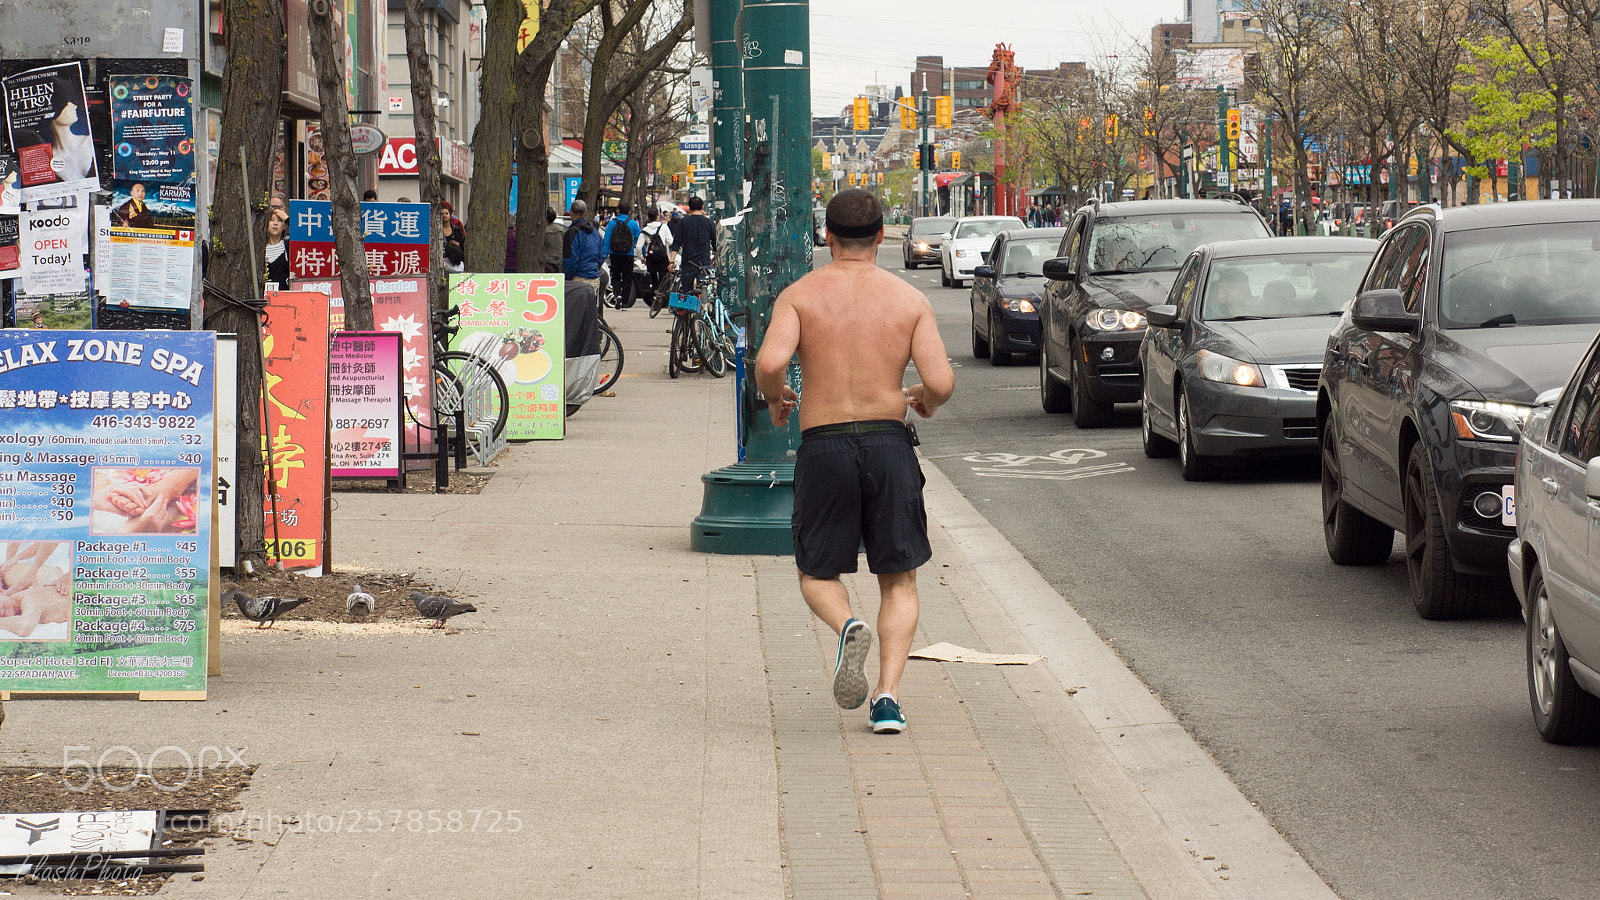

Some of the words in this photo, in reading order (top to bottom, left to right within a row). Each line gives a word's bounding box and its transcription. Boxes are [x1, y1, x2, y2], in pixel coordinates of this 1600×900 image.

[10, 82, 55, 100] HELEN
[10, 101, 19, 110] of
[20, 94, 53, 110] TROY
[121, 107, 186, 118] #FAIRFUTURE
[684, 142, 704, 150] Grange
[160, 189, 191, 199] KARMAPA
[29, 214, 70, 230] koodo
[297, 206, 422, 239] 中貨運
[34, 238, 68, 250] OPEN
[32, 253, 72, 266] Today!
[376, 280, 418, 294] Garden
[66, 339, 145, 367] ZONE
[150, 348, 205, 387] SPA
[92, 415, 197, 429] 416-343-9822
[335, 418, 390, 429] 887-2697
[48, 435, 87, 446] (60min,
[89, 437, 112, 445] Include
[113, 437, 128, 445] soak
[129, 437, 142, 445] foot
[179, 434, 202, 445] $32
[24, 452, 34, 463] &
[37, 451, 96, 466] Massage
[98, 454, 140, 465] (45min)
[179, 452, 202, 464] $40
[17, 470, 77, 485] Massage
[52, 484, 75, 495] $30
[51, 497, 75, 508] $40
[51, 510, 74, 521] $50
[77, 541, 130, 555] Package
[176, 541, 198, 552] $45
[76, 554, 106, 564] 30min
[107, 554, 128, 564] Foot
[137, 554, 167, 564] 30min
[167, 554, 191, 566] Body
[76, 567, 129, 581] Package
[175, 567, 197, 579] $55
[76, 581, 105, 591] 60min
[106, 581, 127, 591] Foot
[136, 581, 166, 591] 30min
[166, 581, 191, 593] Body
[75, 593, 129, 607] Package
[174, 594, 196, 605] $65
[75, 607, 104, 617] 30min
[105, 607, 126, 617] Foot
[135, 607, 165, 617] 60min
[165, 607, 190, 619] Body
[74, 619, 128, 634] Package
[173, 620, 196, 631] $75
[74, 633, 103, 643] 60min
[104, 633, 125, 643] Foot
[134, 633, 164, 643] 60min
[165, 633, 189, 645] Body
[0, 656, 34, 668] Super
[35, 656, 43, 666] 8
[45, 656, 76, 666] Hotel
[78, 656, 98, 666] 3rd
[100, 656, 113, 668] Fl)
[0, 670, 12, 678] 22
[14, 670, 55, 678] SPADIAN
[57, 670, 79, 678] AVE.
